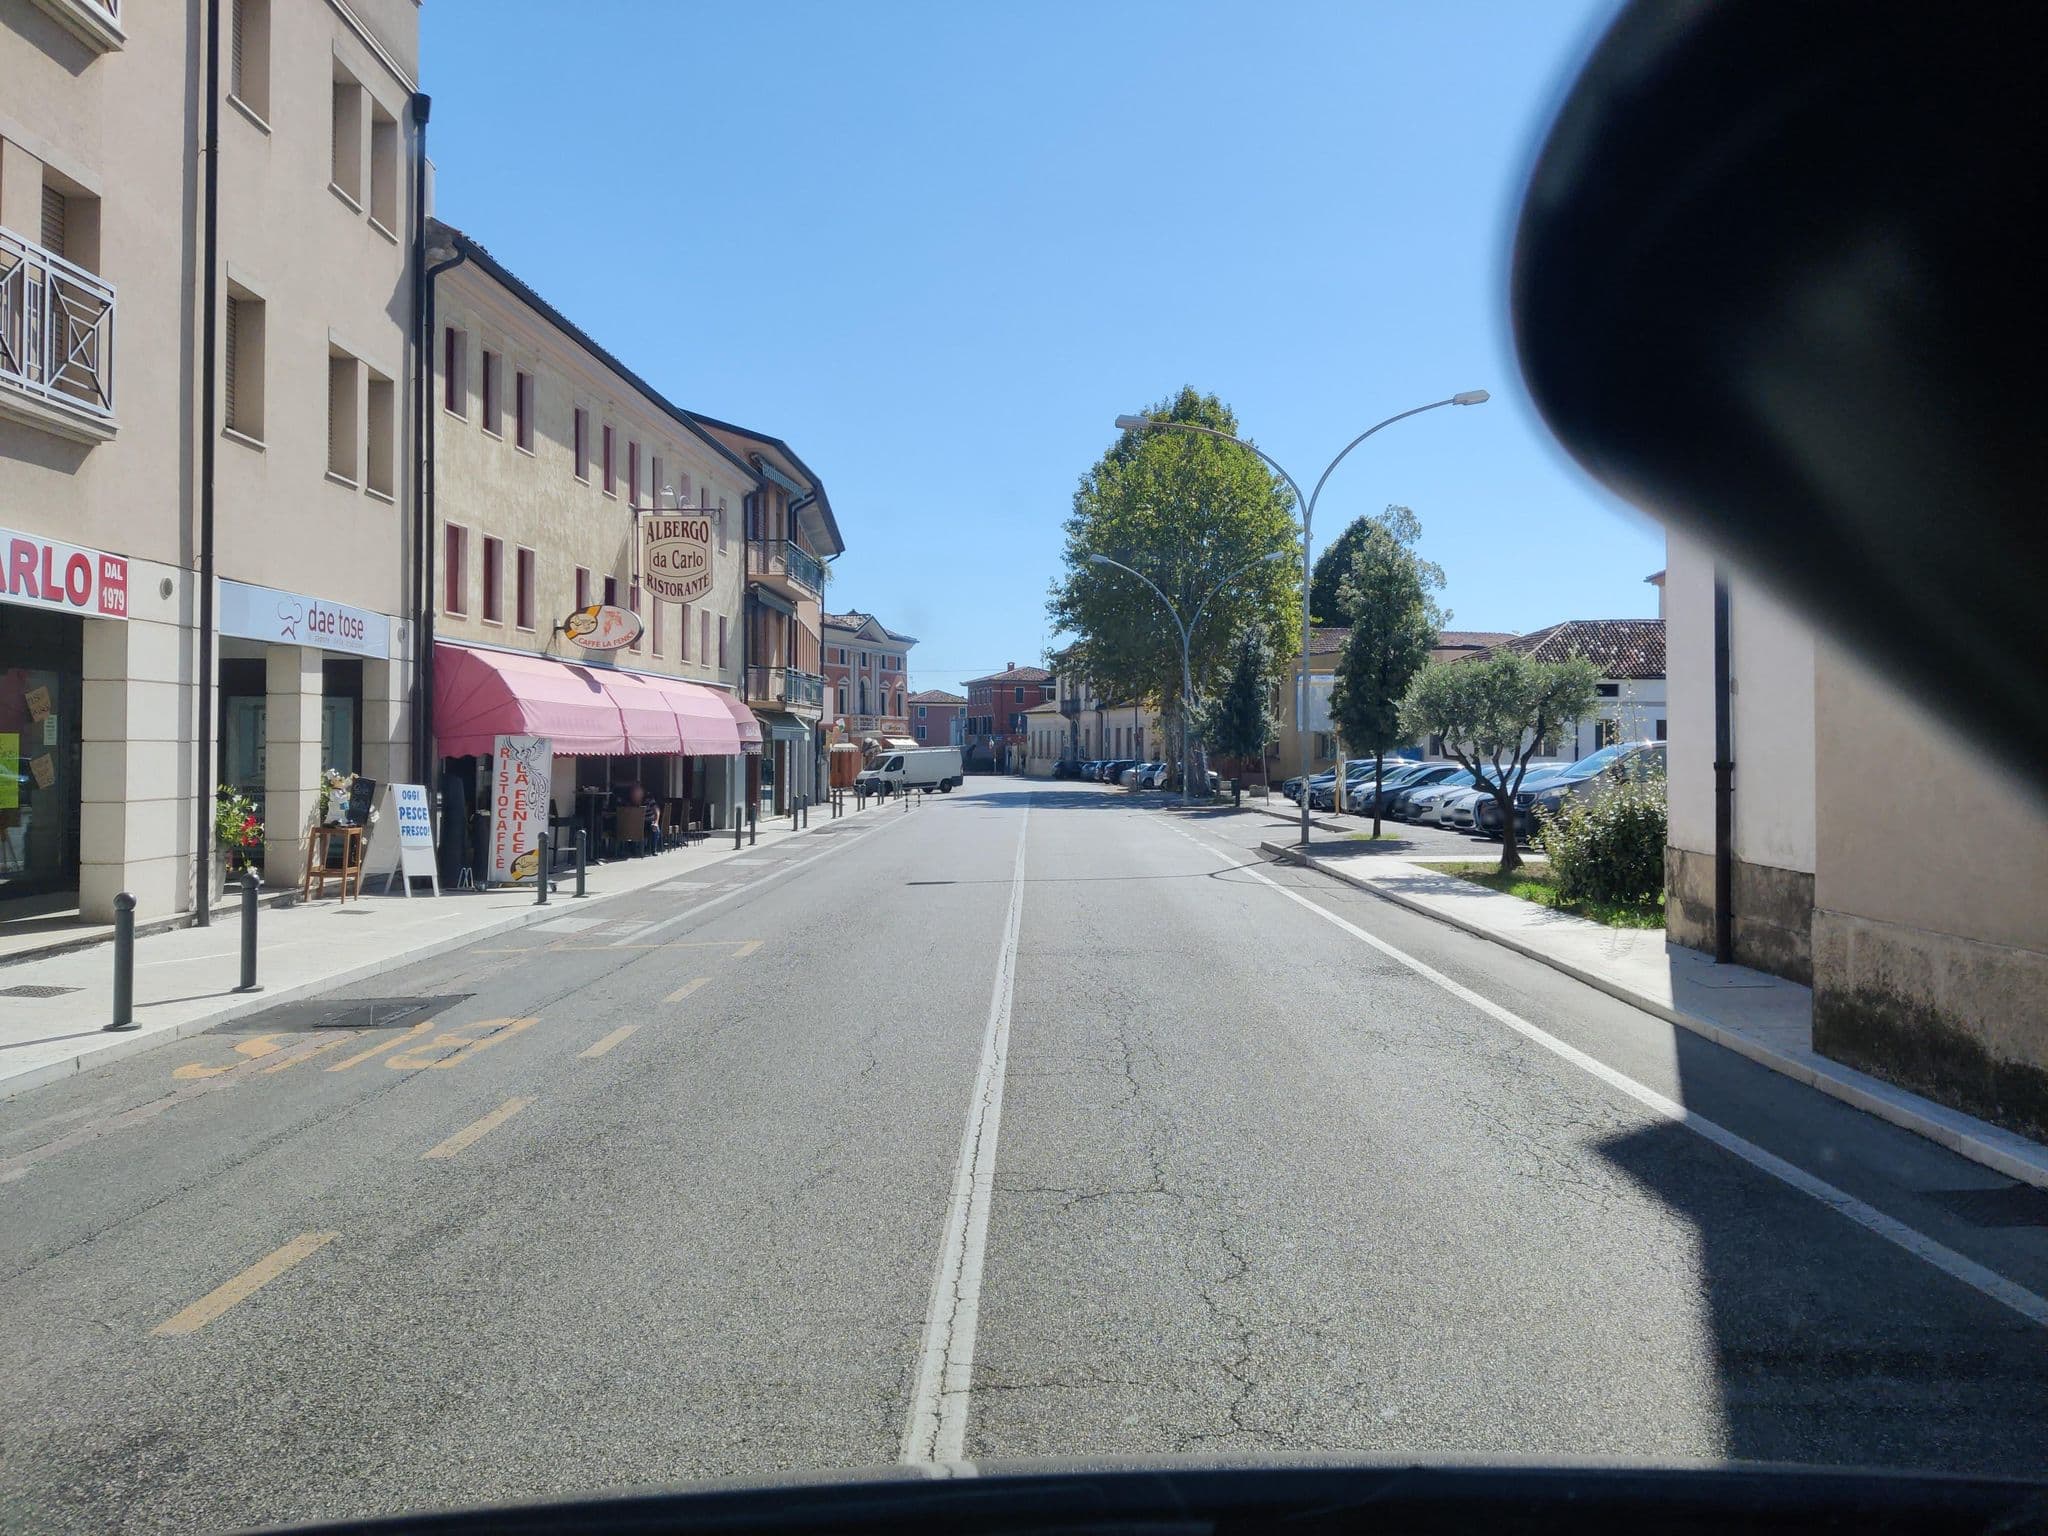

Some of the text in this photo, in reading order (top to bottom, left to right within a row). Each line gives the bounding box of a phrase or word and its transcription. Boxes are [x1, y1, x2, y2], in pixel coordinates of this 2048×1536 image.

[646, 521, 709, 544] ALBERGO
[104, 561, 123, 581] DAL
[653, 550, 703, 569] da Carlo
[0, 538, 92, 607] RLO
[647, 573, 710, 597] RISTORANTE
[103, 586, 125, 611] 1979
[308, 601, 364, 641] dae tose
[514, 762, 529, 785] LA
[401, 790, 420, 801] OGGI
[398, 806, 428, 820] PESCE
[512, 789, 529, 854] FENICE
[401, 825, 431, 837] FRESCO!
